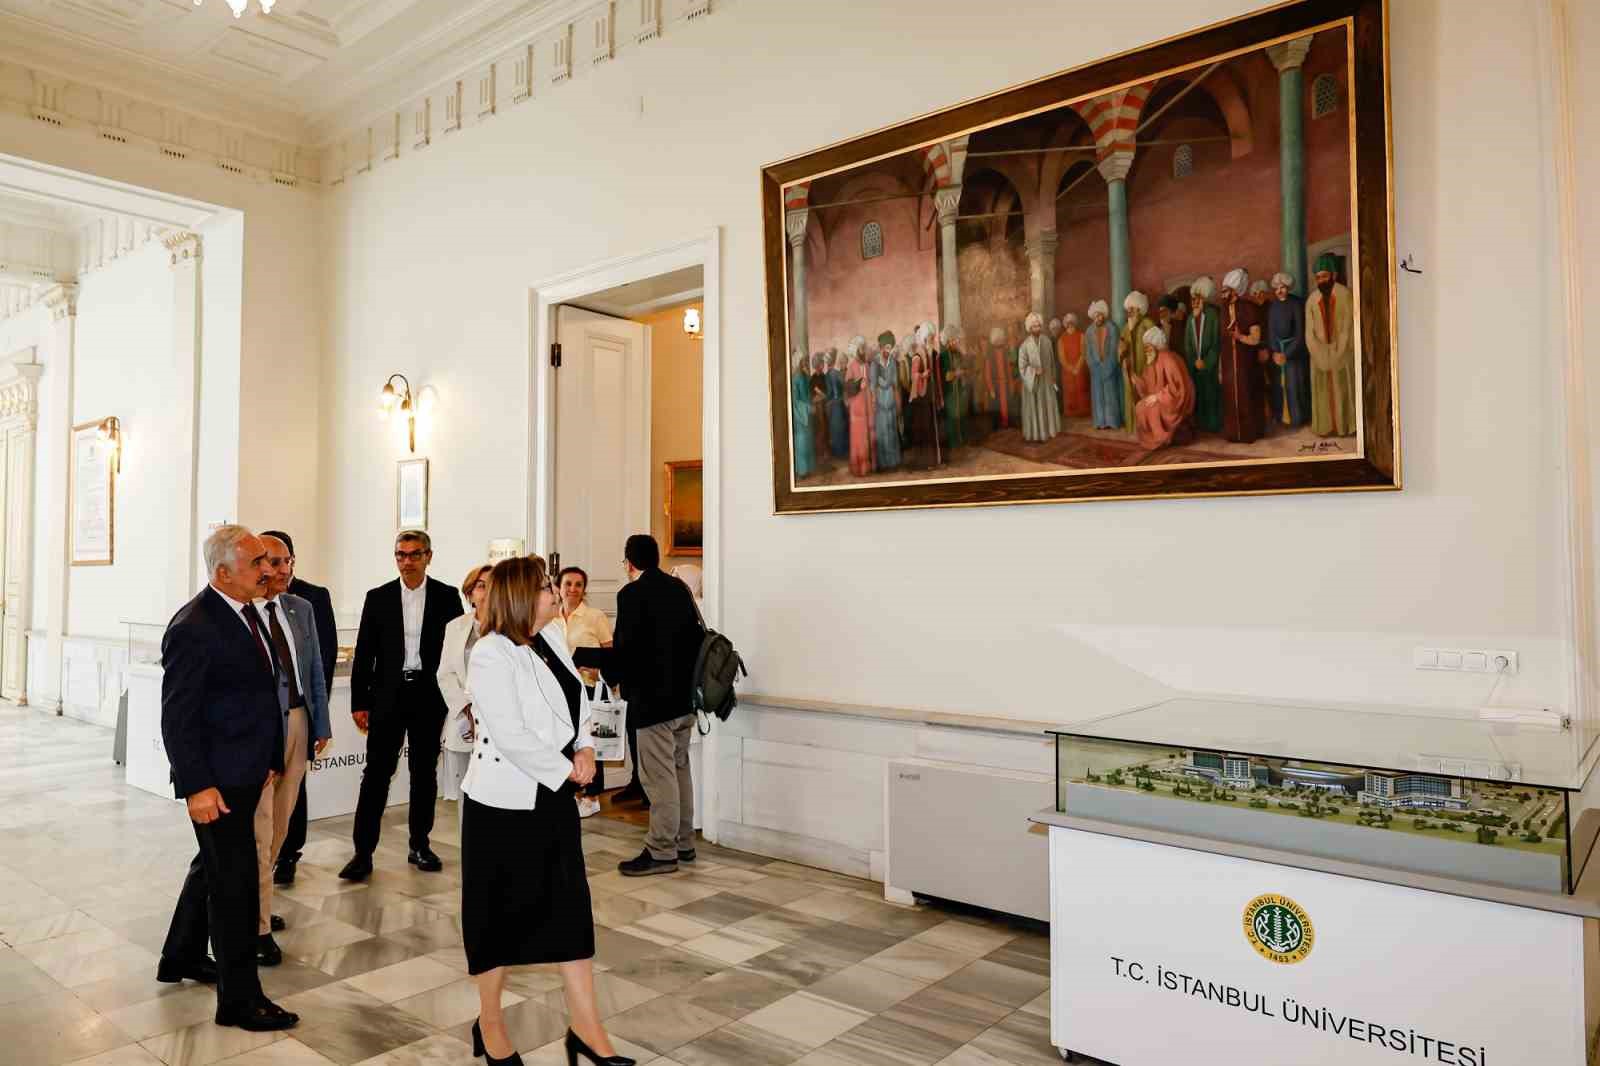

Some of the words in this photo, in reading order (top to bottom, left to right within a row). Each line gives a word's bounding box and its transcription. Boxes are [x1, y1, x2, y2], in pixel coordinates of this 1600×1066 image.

[1268, 952, 1289, 963] 1453
[1110, 956, 1149, 984] T.C.
[1157, 965, 1275, 1017] İSTANBUL
[1282, 998, 1485, 1066] ÜNİVERSİTESİ
